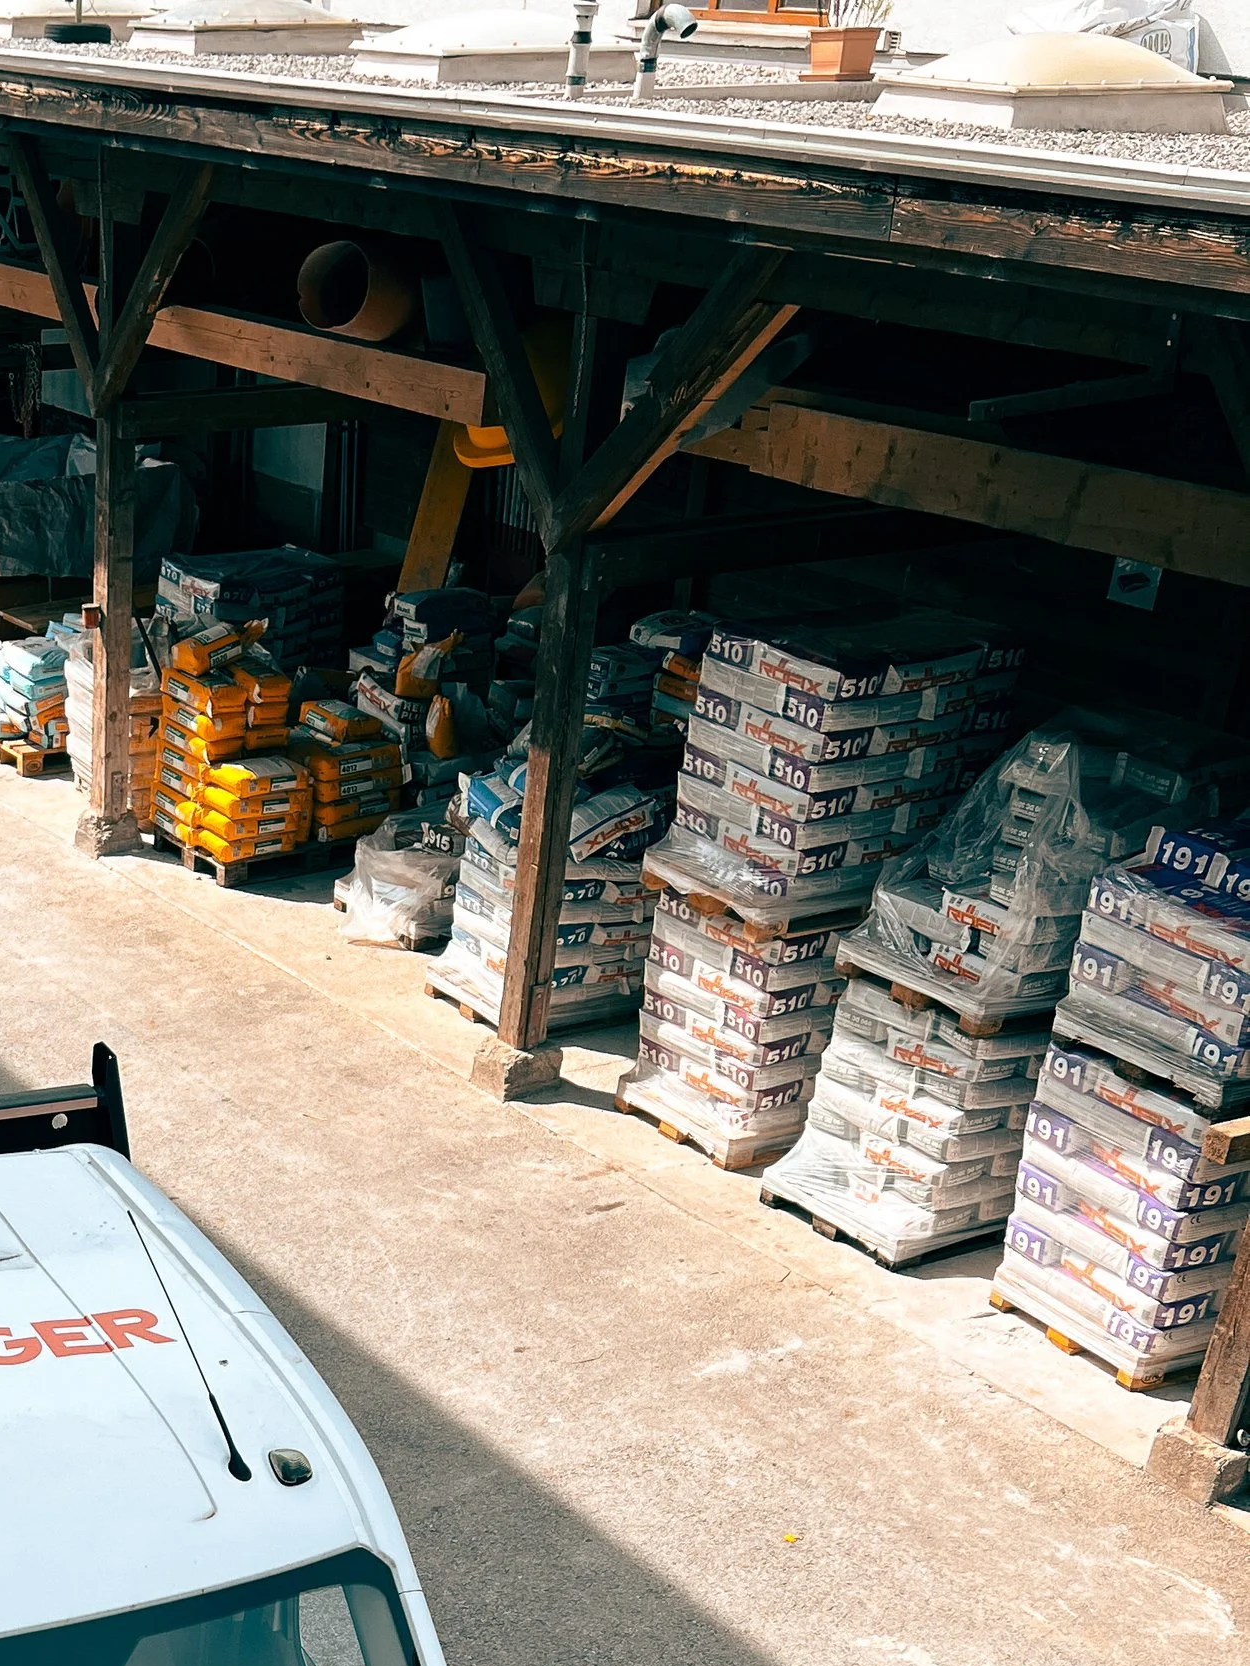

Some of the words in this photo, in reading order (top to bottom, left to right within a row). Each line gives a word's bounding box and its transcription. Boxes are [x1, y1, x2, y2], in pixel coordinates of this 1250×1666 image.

[710, 634, 743, 664] 510
[840, 674, 880, 698] 510
[695, 697, 727, 723] 510
[787, 697, 819, 728] 510
[825, 739, 863, 760] 510
[683, 756, 715, 779] 510
[774, 757, 805, 790] 510
[342, 785, 358, 794] 4012
[811, 798, 848, 819] 510
[429, 829, 451, 852] 915
[761, 821, 791, 846] 510
[801, 852, 839, 874] 510
[1160, 841, 1209, 875] 191
[1226, 873, 1250, 902] 19
[658, 895, 691, 921] 510
[1087, 886, 1128, 921] 191
[650, 945, 680, 971] 510
[783, 941, 817, 961] 510
[734, 957, 764, 987] 510
[1071, 953, 1113, 988] 191
[645, 996, 675, 1021] 510
[772, 993, 807, 1016] 510
[726, 1013, 756, 1039] 510
[639, 1042, 670, 1069] 510
[766, 1042, 800, 1065] 510
[1191, 1037, 1238, 1077] 191
[1043, 1050, 1082, 1086] 191
[759, 1092, 791, 1112] 510
[1025, 1112, 1064, 1149] 191
[1151, 1139, 1194, 1179] 191
[1017, 1170, 1054, 1206] 191
[1186, 1183, 1236, 1208] 191
[1136, 1198, 1176, 1239] 191
[1007, 1226, 1044, 1261] 191
[1171, 1242, 1222, 1268] 191
[1127, 1260, 1165, 1299] 191
[1161, 1299, 1209, 1327] 191
[1110, 1311, 1151, 1353] 191
